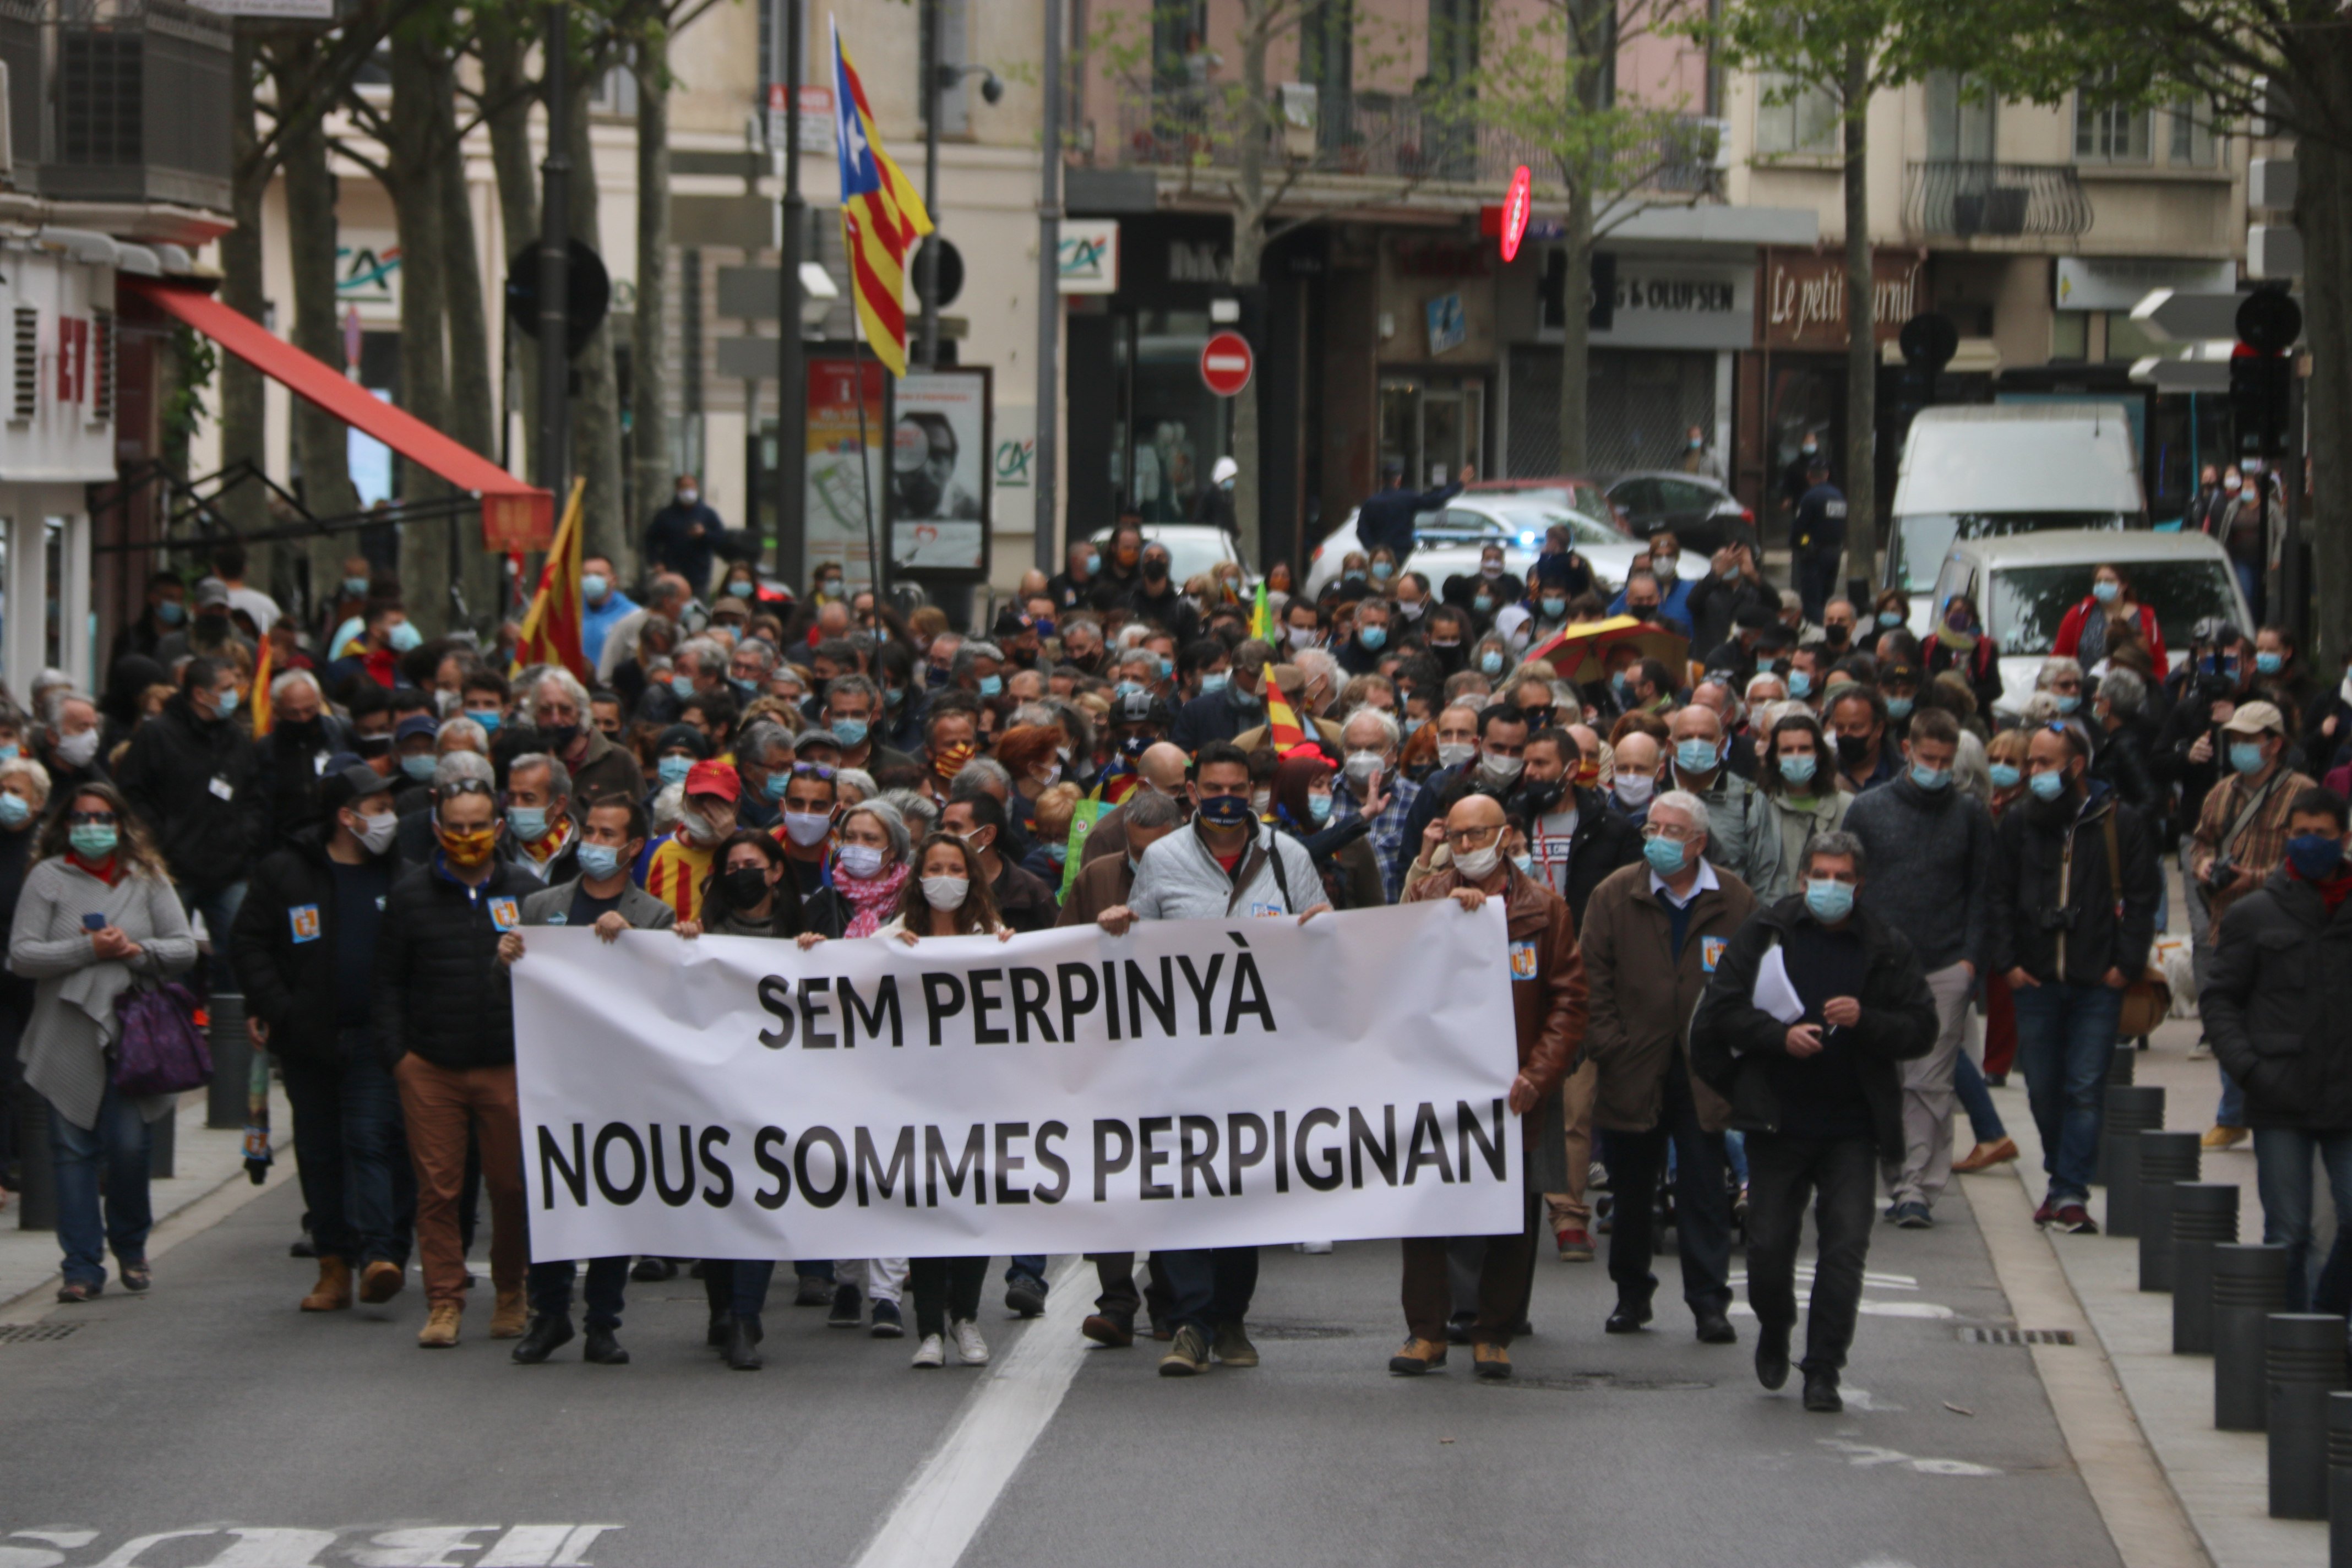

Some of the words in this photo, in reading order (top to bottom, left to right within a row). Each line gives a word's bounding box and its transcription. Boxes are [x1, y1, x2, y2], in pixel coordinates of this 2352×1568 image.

[1648, 279, 1734, 312] OLUFSEN
[1771, 265, 1795, 324] Le
[1793, 266, 1843, 341] petit
[758, 973, 903, 1049] SEM
[921, 930, 1277, 1047] PERPINYÀ
[538, 1121, 734, 1210] NOUS
[754, 1121, 1070, 1210] SOMMES
[1093, 1098, 1506, 1204] PERPIGNAN
